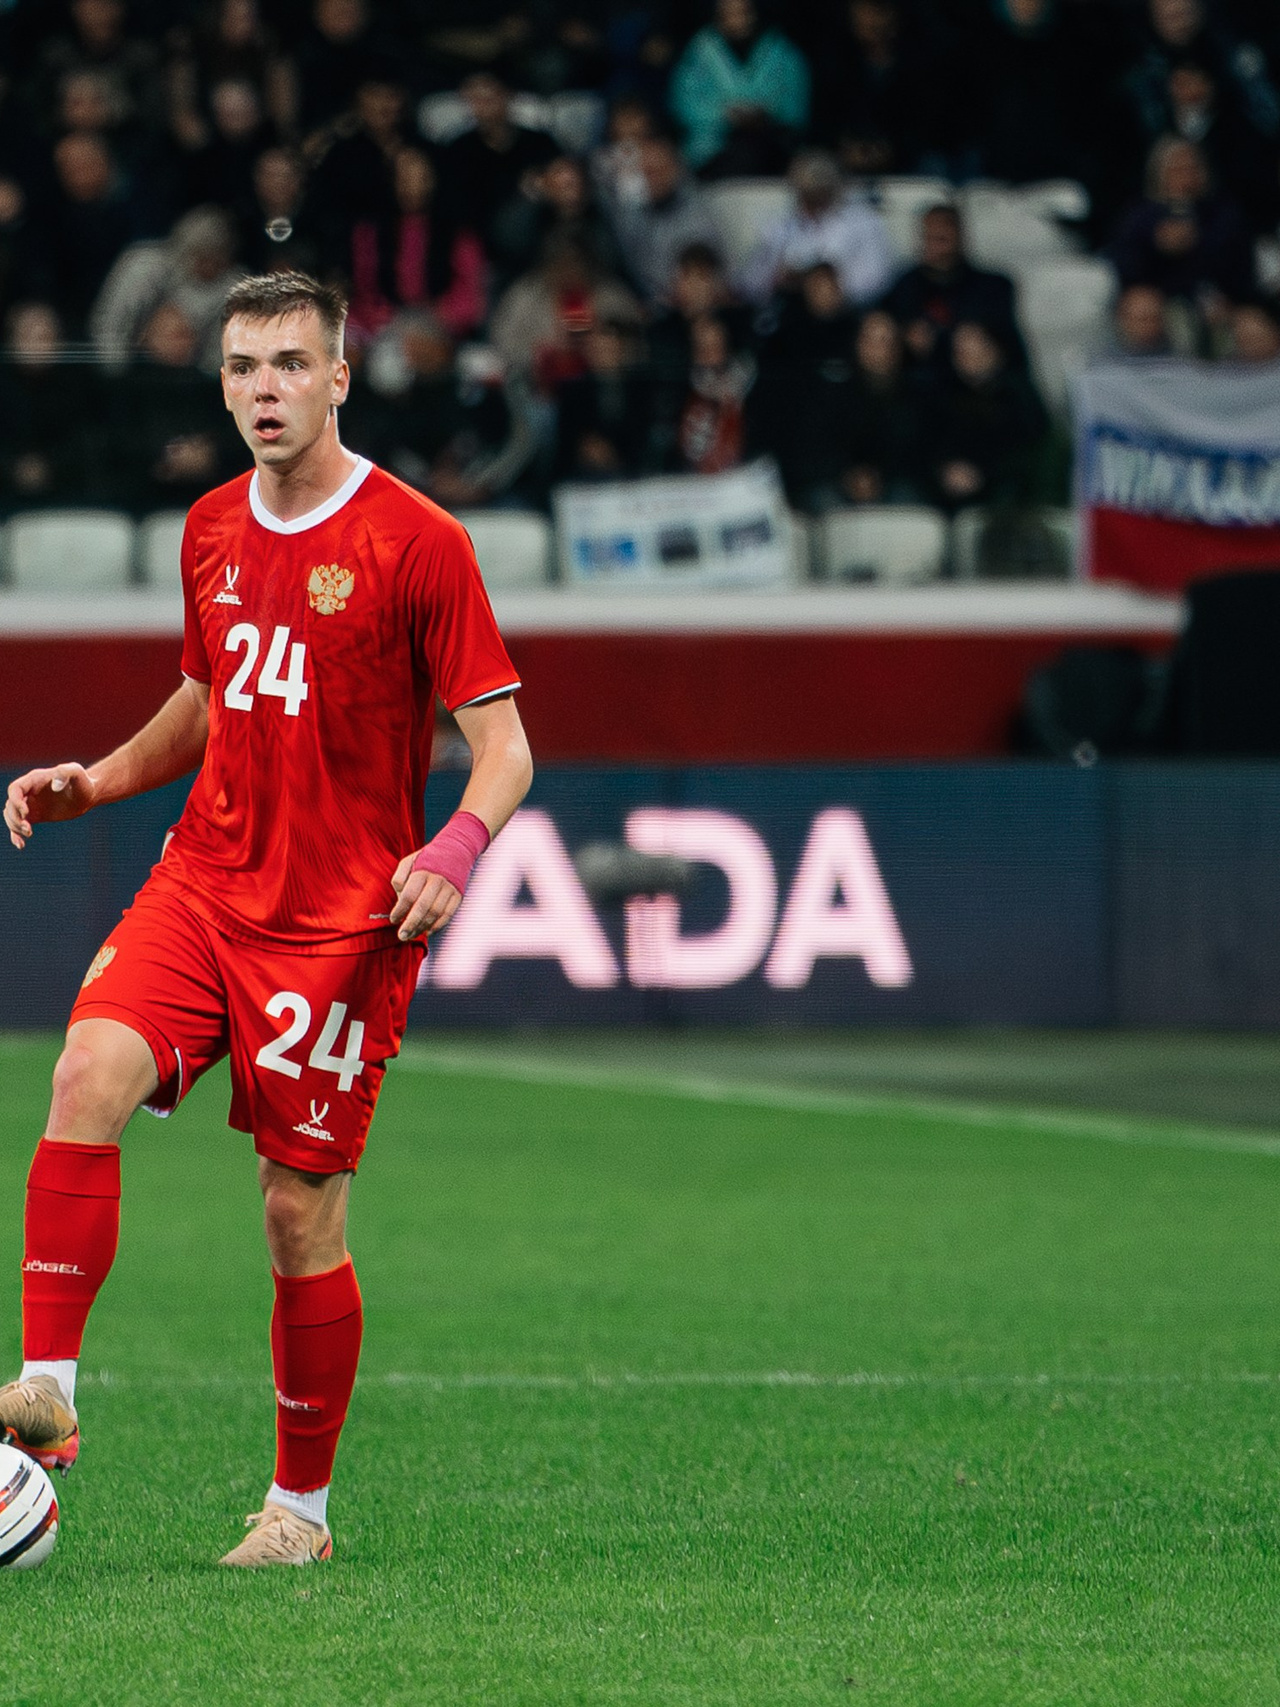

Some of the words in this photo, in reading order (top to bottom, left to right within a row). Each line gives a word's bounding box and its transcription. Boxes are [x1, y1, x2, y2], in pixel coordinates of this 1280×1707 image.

[224, 622, 309, 717] 24
[418, 806, 914, 990] ADA
[255, 991, 366, 1092] 24
[292, 1122, 335, 1142] JÖGEL
[22, 1259, 87, 1276] JÖGEL
